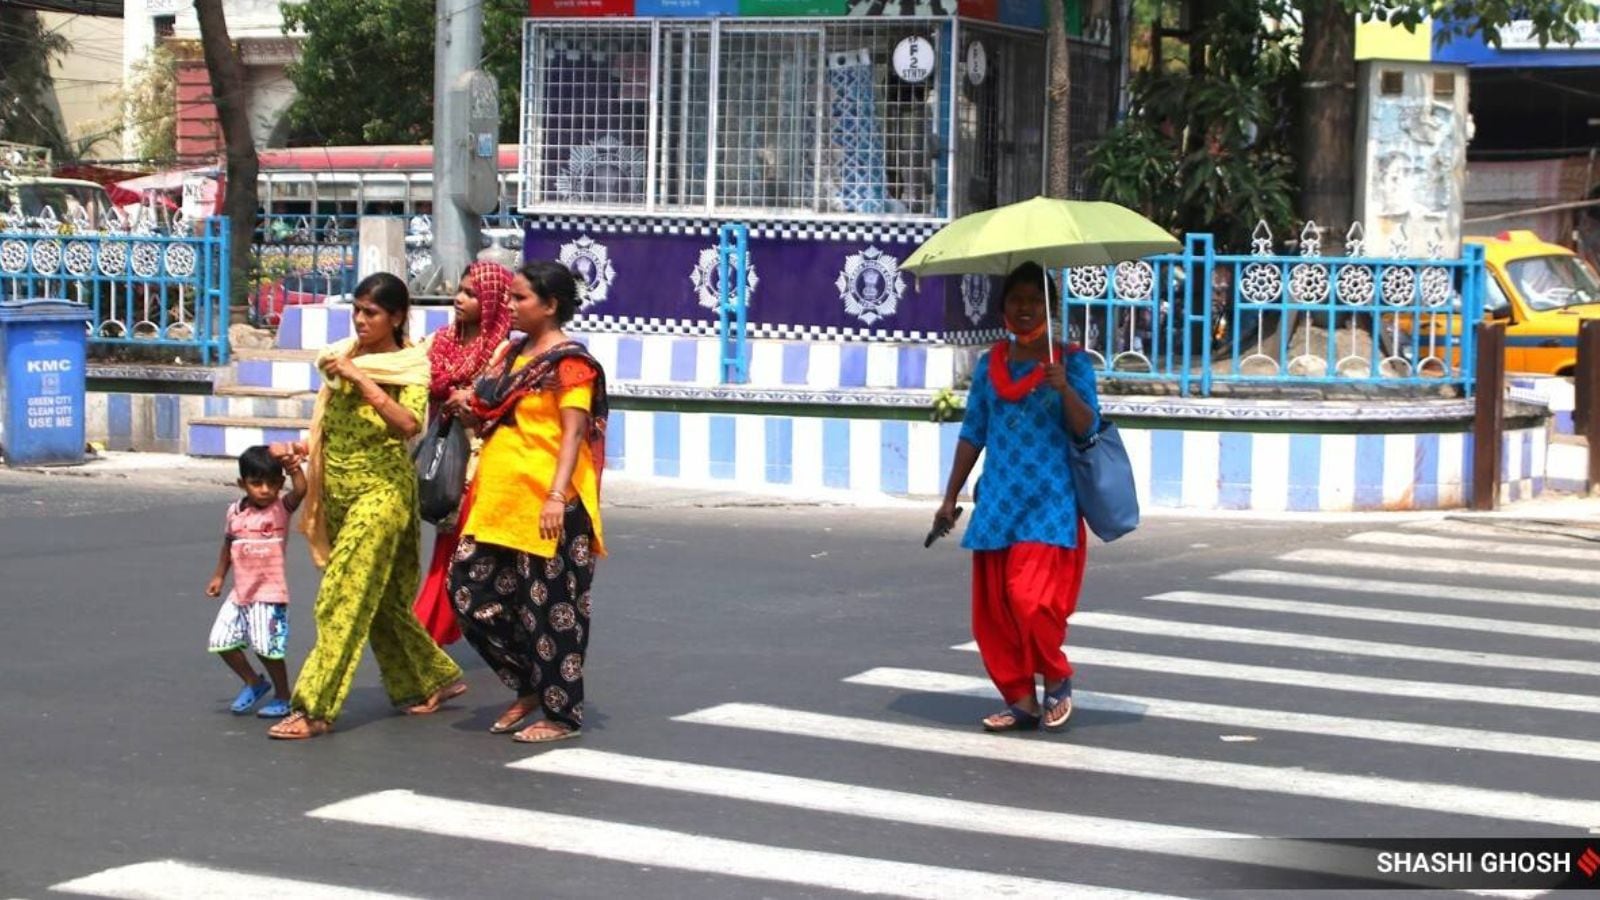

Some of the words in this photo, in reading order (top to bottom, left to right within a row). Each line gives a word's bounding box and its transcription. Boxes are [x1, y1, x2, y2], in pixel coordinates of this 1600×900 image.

[27, 359, 72, 373] KMC
[27, 396, 54, 406] GREEN
[55, 395, 73, 405] CITY
[27, 406, 54, 417] CLEAN
[55, 405, 73, 415] CITY
[27, 417, 53, 429] USE
[55, 416, 73, 427] ME
